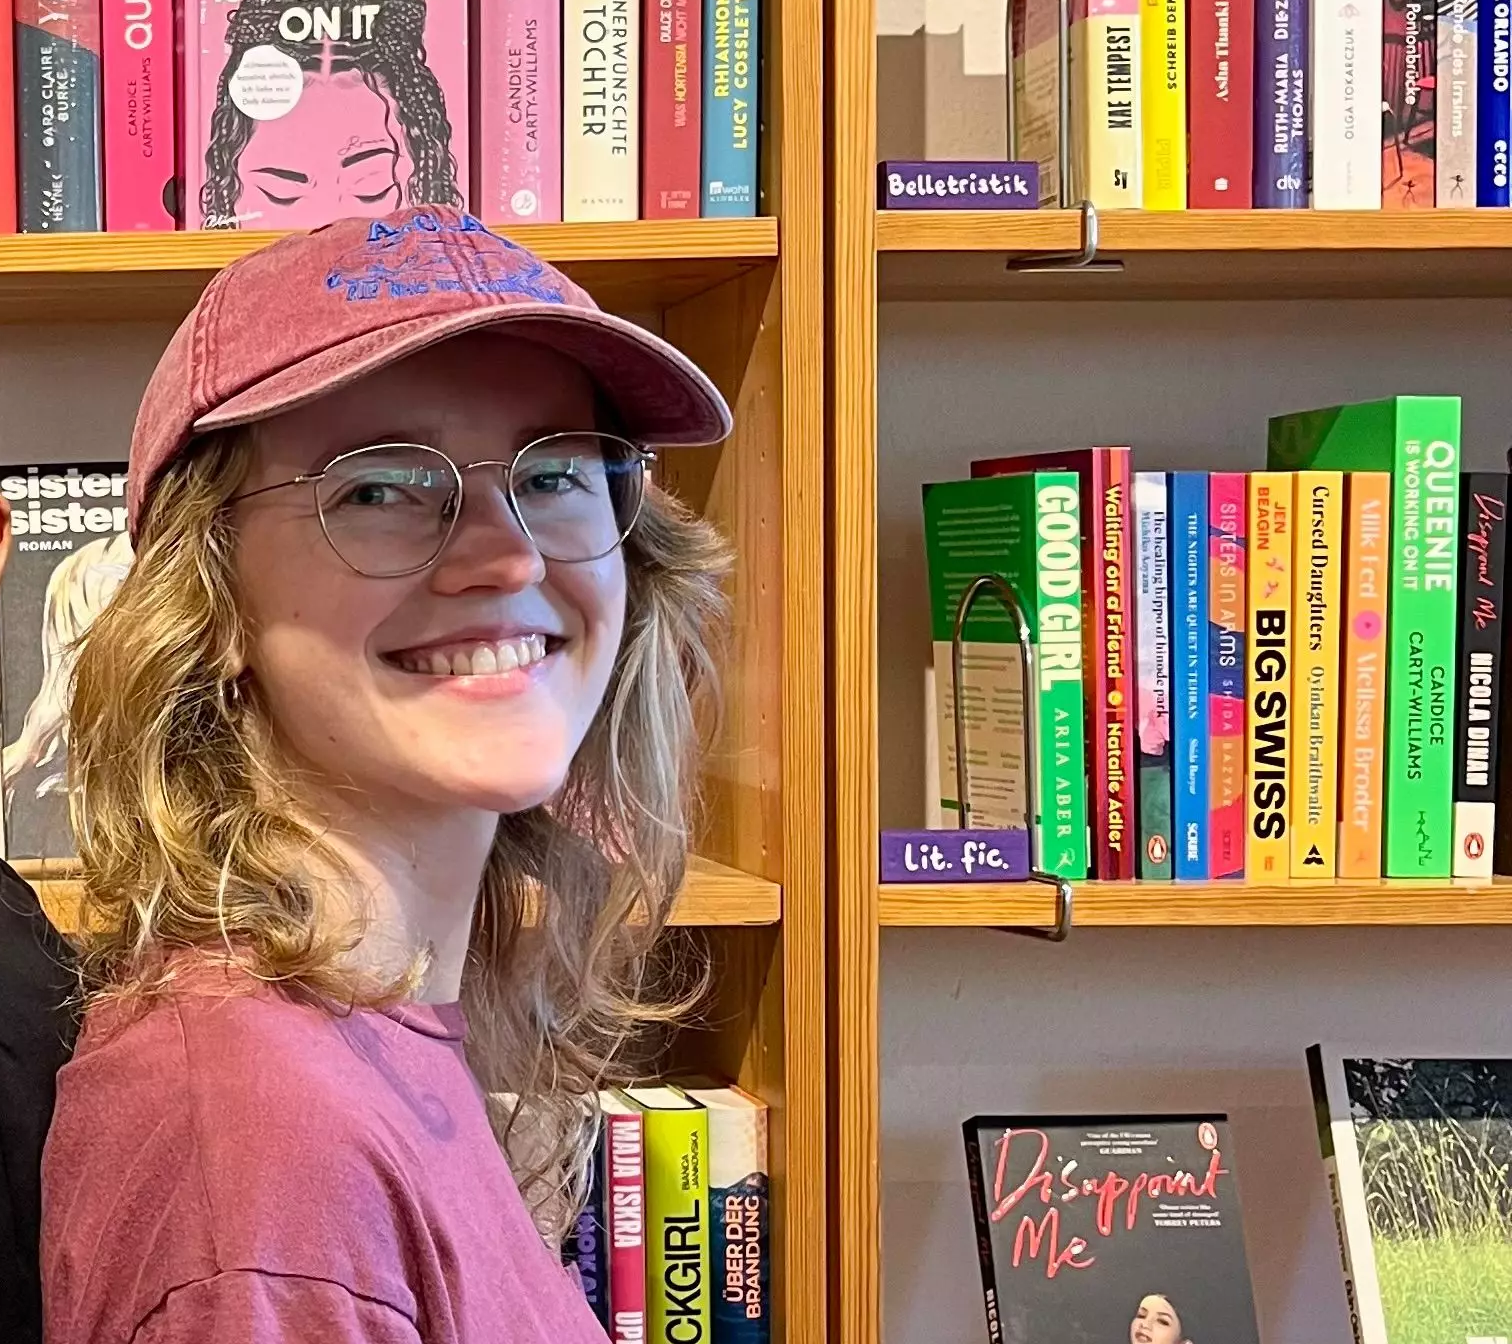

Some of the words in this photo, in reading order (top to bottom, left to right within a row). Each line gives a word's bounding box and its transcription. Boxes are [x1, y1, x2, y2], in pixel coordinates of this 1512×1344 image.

[278, 6, 342, 41] ON
[351, 5, 381, 40] IT
[1493, 3, 1509, 92] ORLANDO
[583, 4, 607, 138] TÖCHTER
[1106, 25, 1132, 94] TEMPEST
[1166, 27, 1178, 90] SCHREIB
[732, 100, 749, 149] LUCY
[1107, 101, 1133, 130] KAE
[1273, 53, 1289, 154] RUTH-MARIA
[1290, 68, 1304, 138] THOMAS
[888, 173, 1029, 196] Belletristik
[0, 467, 128, 500] sister
[1423, 439, 1456, 592] QUEENIE
[9, 502, 129, 534] sister
[19, 539, 73, 551] ROMAN
[1037, 484, 1080, 599] GOOD
[1257, 487, 1269, 551] BEAGIN
[1273, 500, 1286, 534] JEN
[1039, 610, 1082, 691] GIRL
[1254, 609, 1286, 681] BIG
[1054, 707, 1069, 766] ARIA
[1406, 630, 1424, 781] CARTY-WILLIAMS
[1430, 665, 1445, 746] CANDICE
[1253, 691, 1287, 840] SWISS
[1055, 777, 1072, 839] ABER
[960, 841, 1009, 874] fic.
[612, 1120, 641, 1184] MAJA
[991, 1126, 1230, 1238] Disappoint
[613, 1189, 642, 1249] ISKRA
[724, 1195, 743, 1242] DER
[1011, 1207, 1096, 1279] Me
[721, 1246, 744, 1303] ÜBER
[745, 1195, 762, 1320] BRANDUNG
